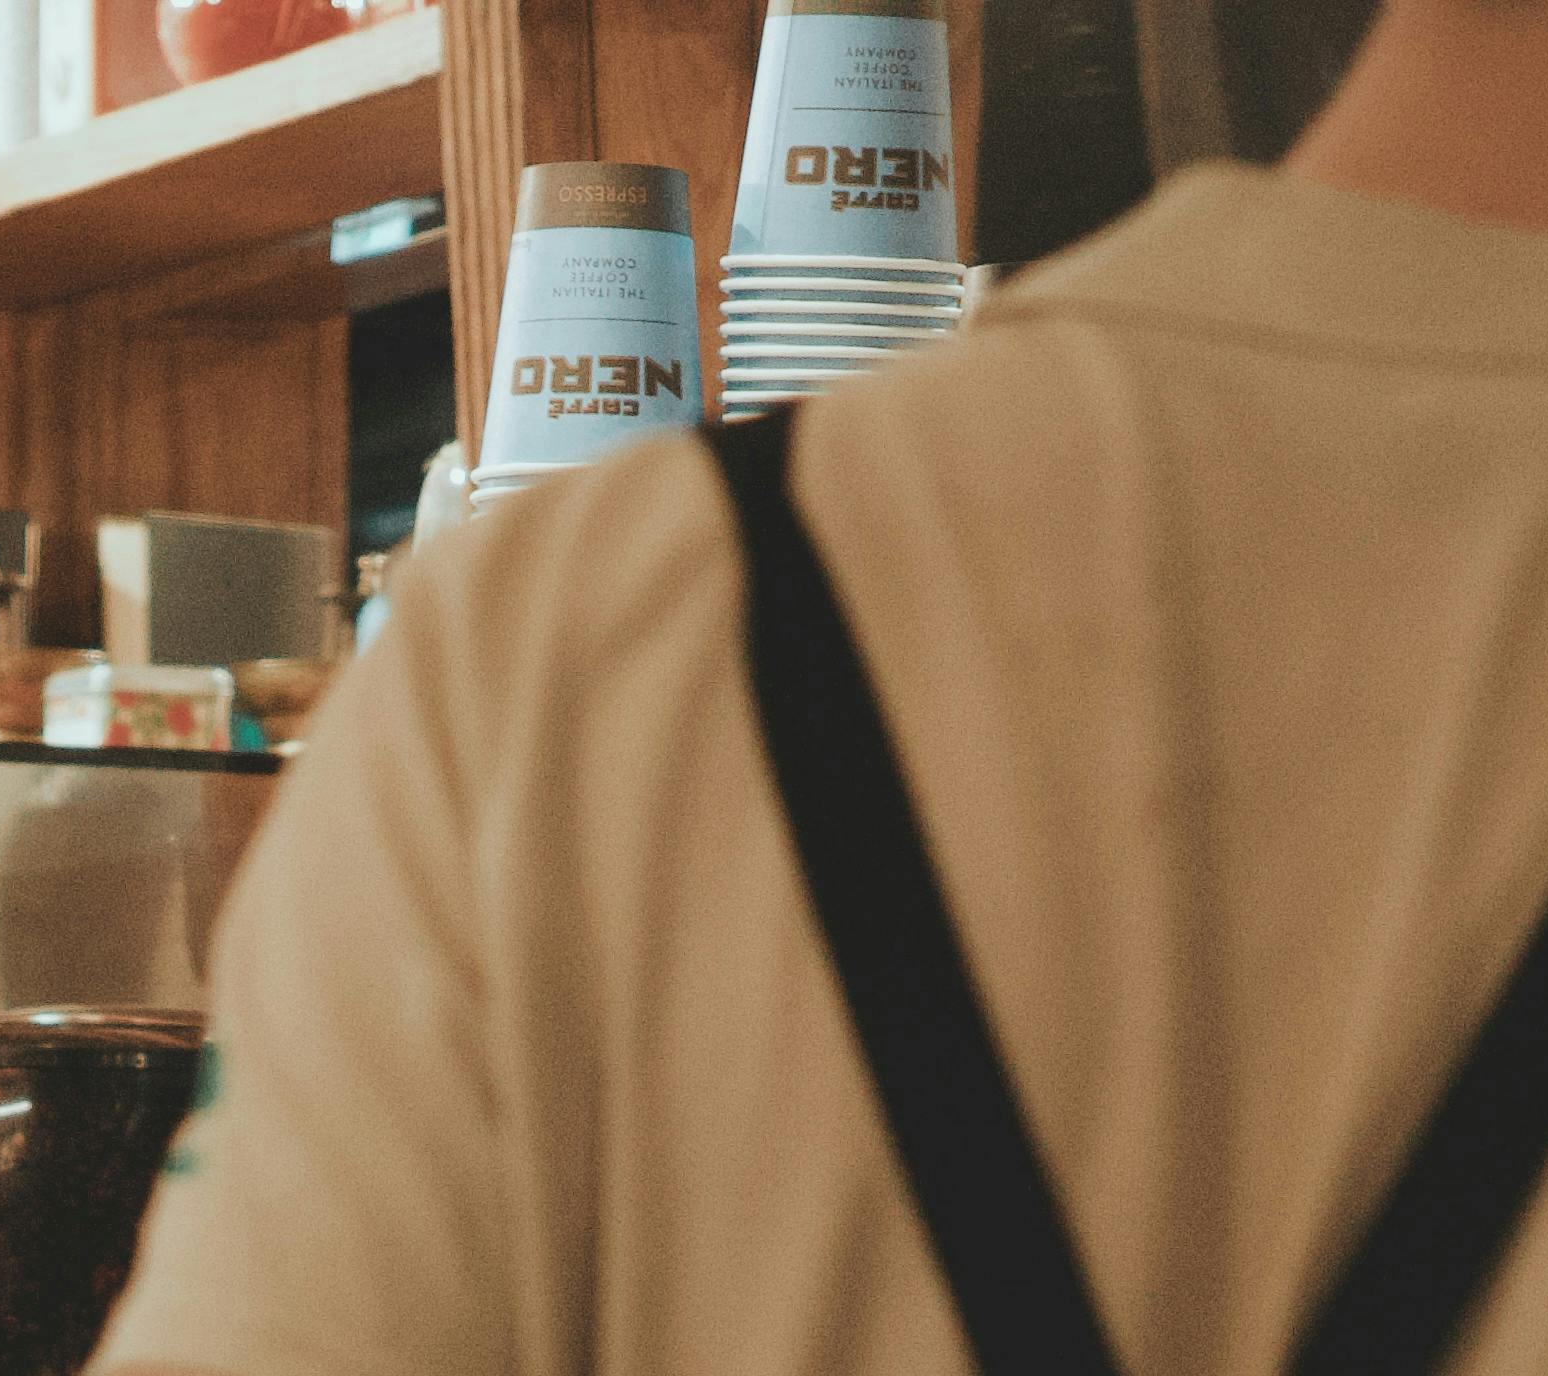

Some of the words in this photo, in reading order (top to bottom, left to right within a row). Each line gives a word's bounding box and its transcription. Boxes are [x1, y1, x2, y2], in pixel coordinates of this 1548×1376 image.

[845, 47, 916, 60] COMPANY
[855, 63, 910, 75] COFFEE
[834, 77, 893, 89] ITALIAN
[900, 80, 922, 92] THE
[784, 145, 949, 191] NERO
[559, 184, 649, 203] ESPRESSO
[562, 257, 636, 269] COMPANY
[570, 272, 627, 283] COFFEE
[553, 287, 610, 298] ITALIAN
[619, 289, 645, 299] THE
[511, 355, 683, 400] NERO
